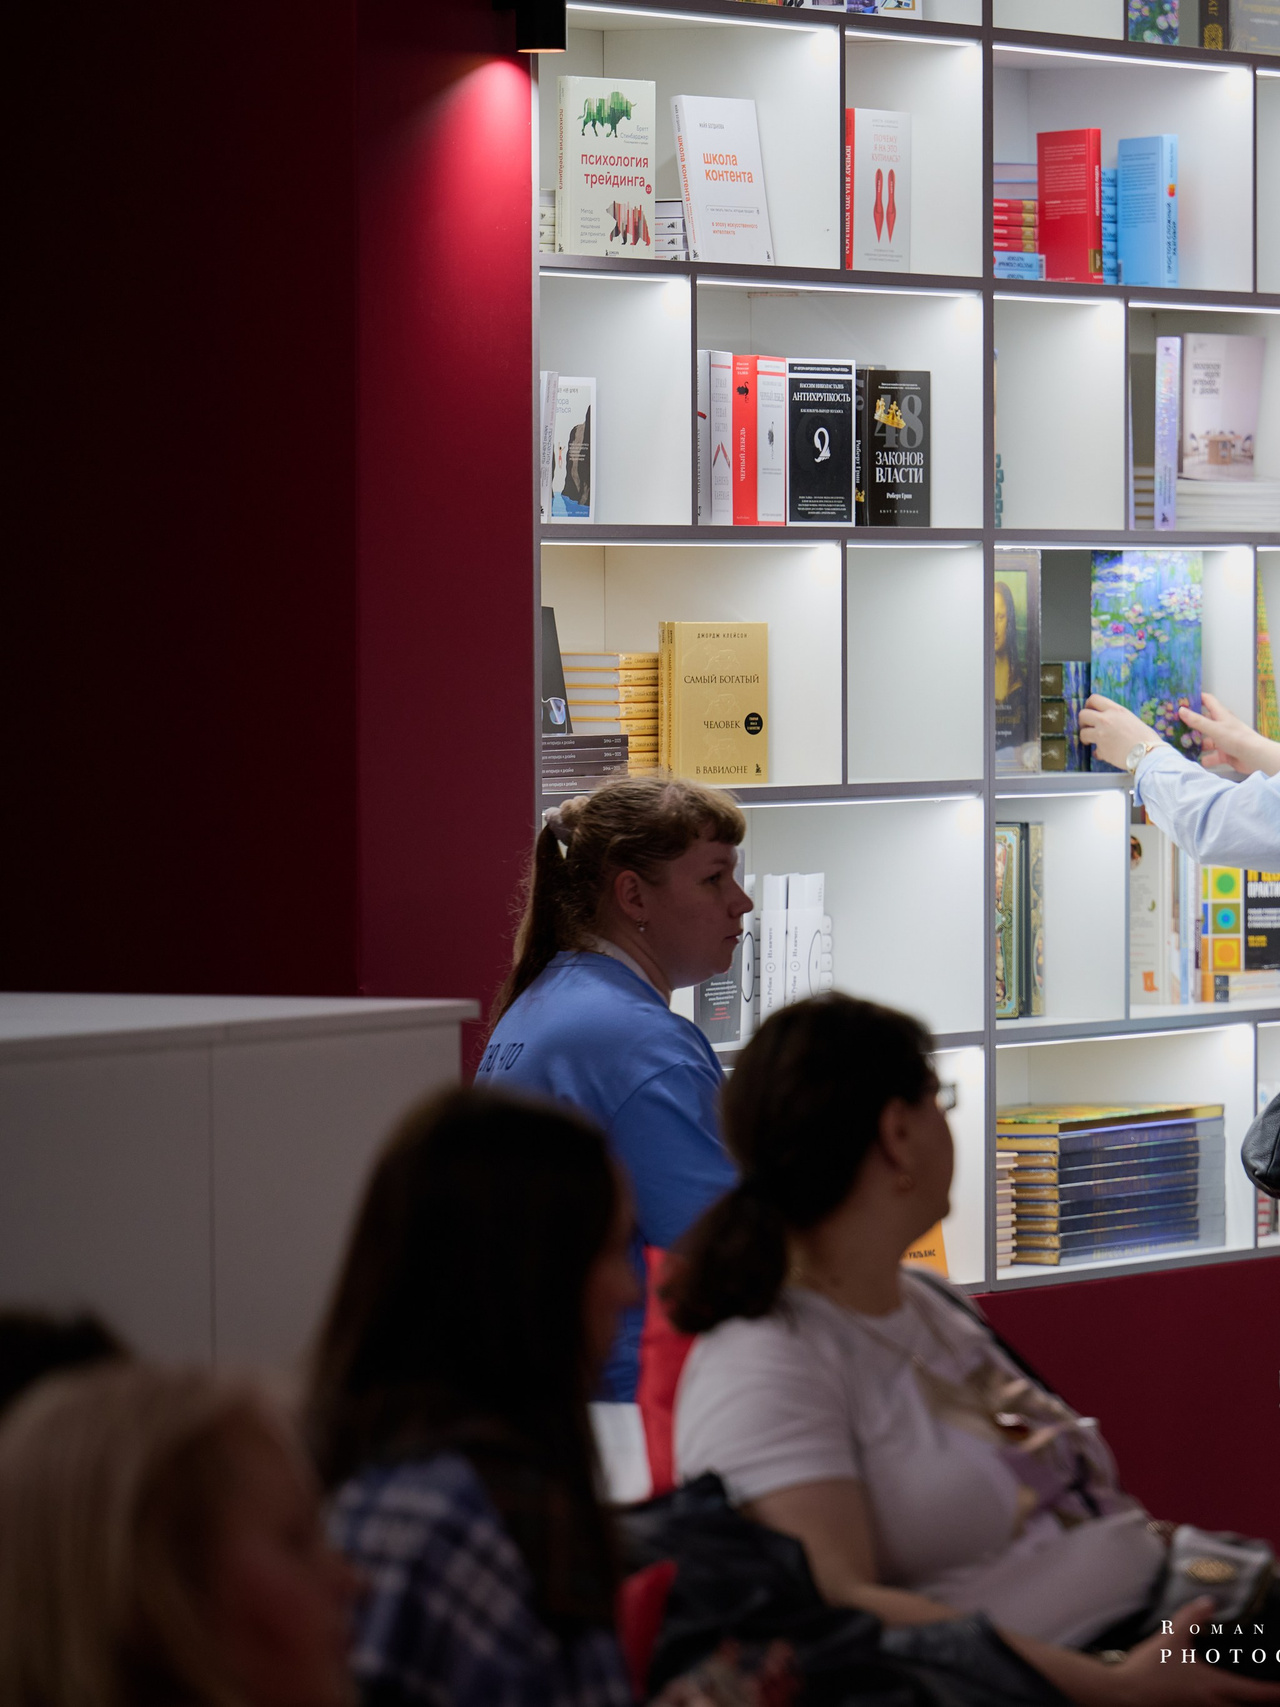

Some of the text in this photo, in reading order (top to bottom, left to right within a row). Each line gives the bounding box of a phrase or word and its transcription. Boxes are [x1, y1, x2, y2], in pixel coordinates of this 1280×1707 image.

[581, 154, 648, 168] психология
[703, 153, 738, 166] школа
[584, 172, 645, 188] трейдинга
[705, 169, 753, 183] контента
[792, 392, 851, 402] АНТИХРУПКОСТЬ
[874, 394, 924, 448] 48
[876, 451, 924, 465] ЗАКОНОВ
[876, 468, 923, 483] ВЛАСТИ
[684, 674, 759, 684] САМЫЙ БОГАТЫЙ
[704, 720, 741, 729] ЧЕЛОВЕК
[696, 766, 748, 774] В ВАВИЛОНЕ
